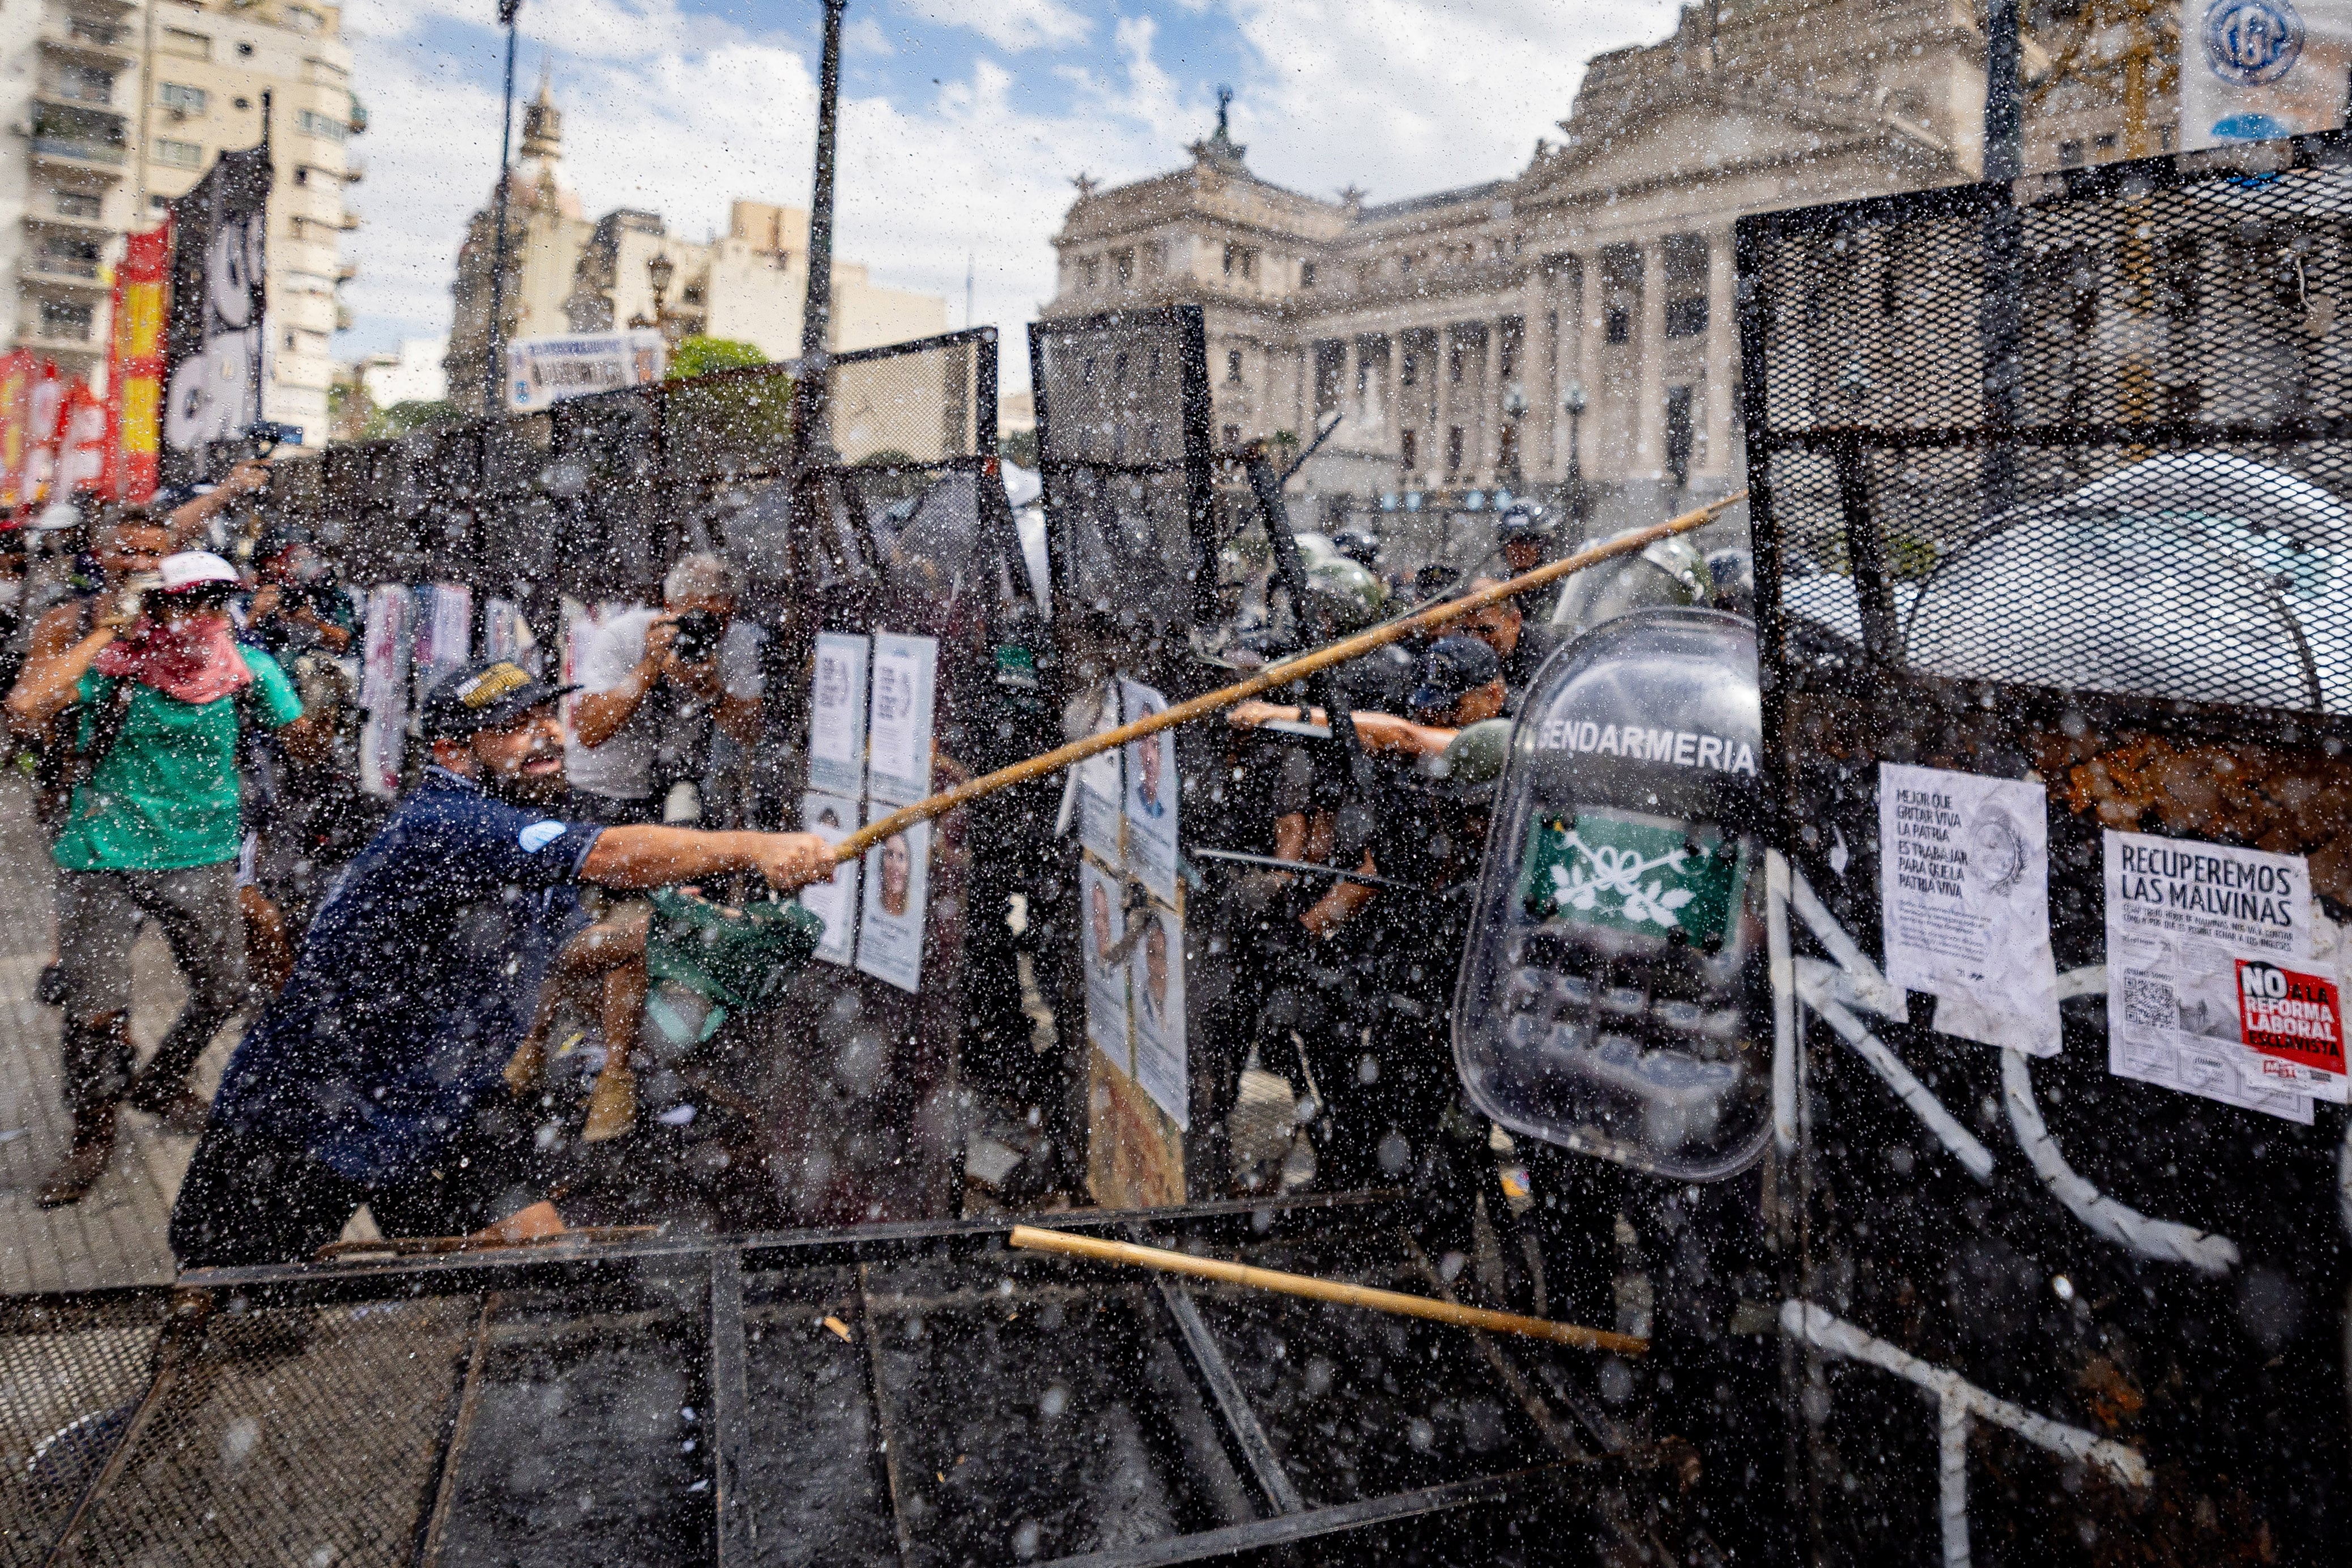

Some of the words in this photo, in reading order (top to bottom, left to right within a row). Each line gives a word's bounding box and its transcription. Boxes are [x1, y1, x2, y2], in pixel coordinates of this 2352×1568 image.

[1897, 821, 1911, 837] LA
[1912, 824, 1950, 843] PATRIA
[1935, 811, 1962, 828] VIVA
[1898, 840, 1911, 855] ES
[1911, 842, 1968, 866] TRABAJAR
[1898, 855, 1927, 875] PARA
[1950, 866, 1965, 882] LA
[2121, 843, 2293, 896] RECUPEREMOS
[1898, 873, 1936, 893] PATRIA
[1936, 880, 1963, 900] VIVA
[2121, 874, 2163, 905] LAS
[2168, 881, 2293, 927] MALVINAS
[2240, 964, 2288, 999] NO
[2291, 984, 2303, 1000] A
[2306, 986, 2329, 1005] LA
[2244, 995, 2335, 1024] REFORMA
[2247, 1011, 2338, 1042] LABORAL
[2248, 1030, 2341, 1058] ESCLAVISTA
